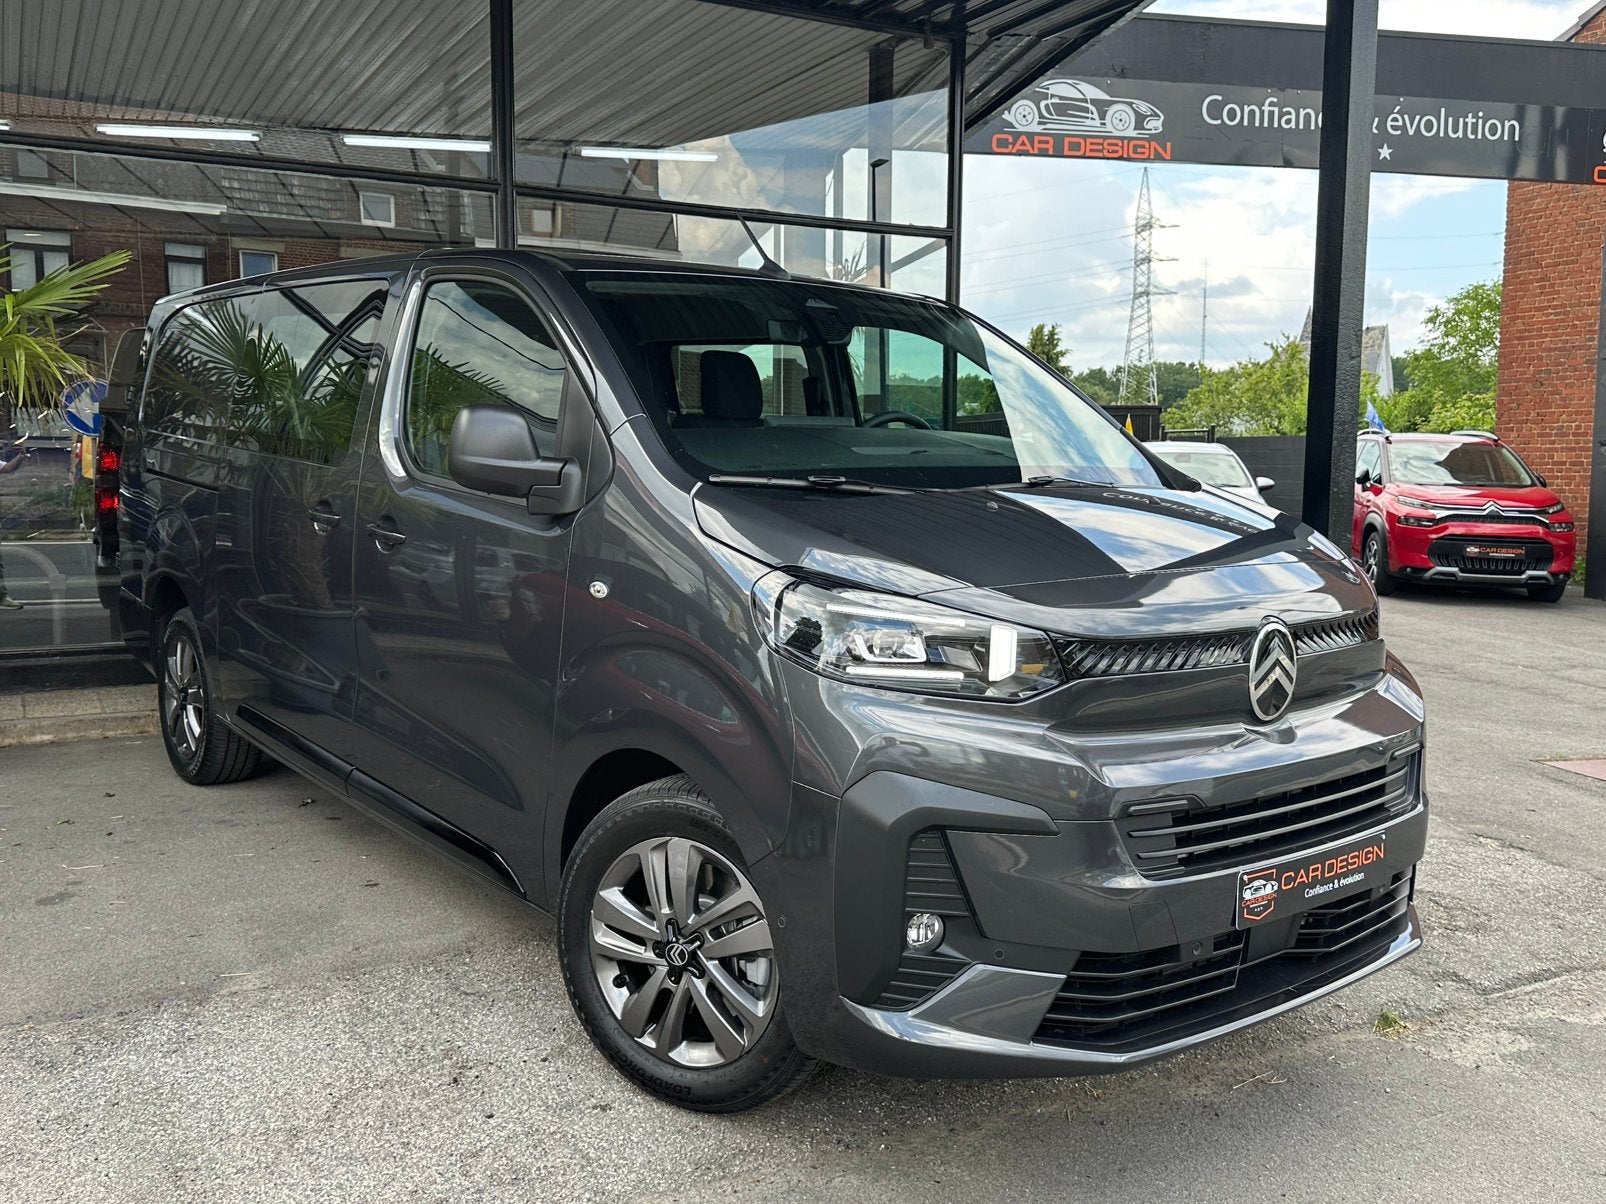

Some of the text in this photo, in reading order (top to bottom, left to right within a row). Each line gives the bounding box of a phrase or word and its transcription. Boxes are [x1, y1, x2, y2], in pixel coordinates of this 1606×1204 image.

[1202, 95, 1323, 131] Confian
[1386, 105, 1521, 142] évolution
[991, 133, 1172, 160] CAR DESIGN
[1281, 843, 1385, 890] CAR DESIGN
[1304, 872, 1365, 898] Confiance & évolution
[1241, 892, 1277, 907] CAR DESIGN
